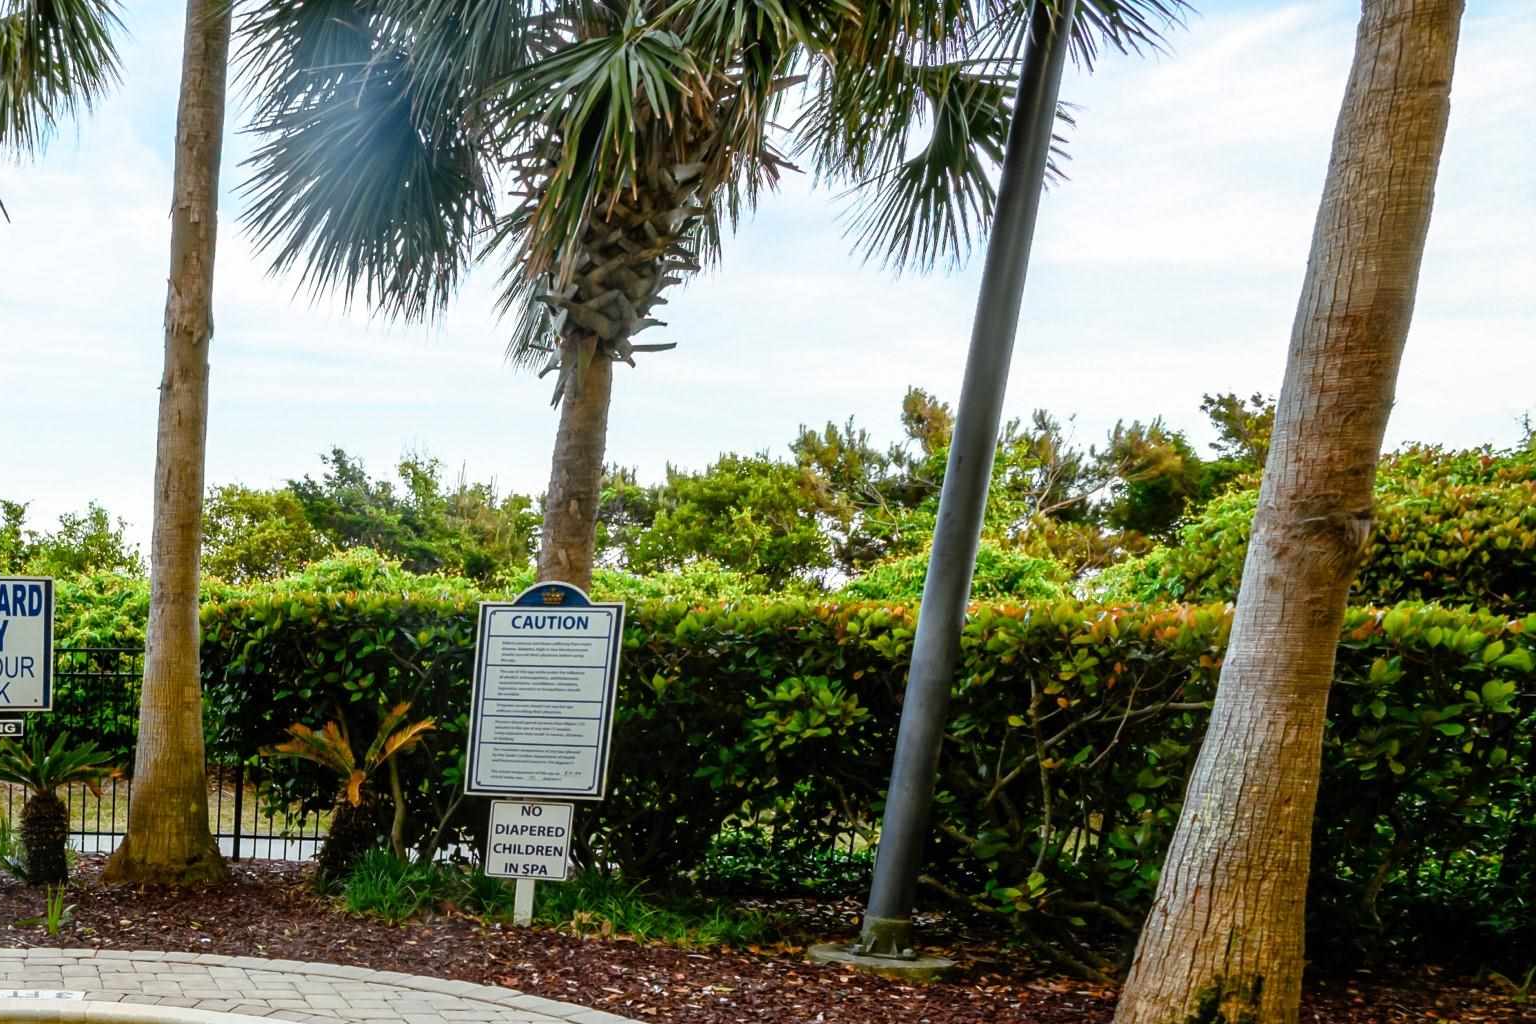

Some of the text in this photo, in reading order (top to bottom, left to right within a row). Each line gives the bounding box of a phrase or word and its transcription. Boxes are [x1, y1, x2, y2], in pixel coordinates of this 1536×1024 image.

[511, 615, 589, 630] CAUTION
[521, 806, 543, 817] NO
[495, 824, 566, 838] DIAPERED
[493, 843, 564, 857] CHILDREN
[504, 862, 548, 875] IN SPA
